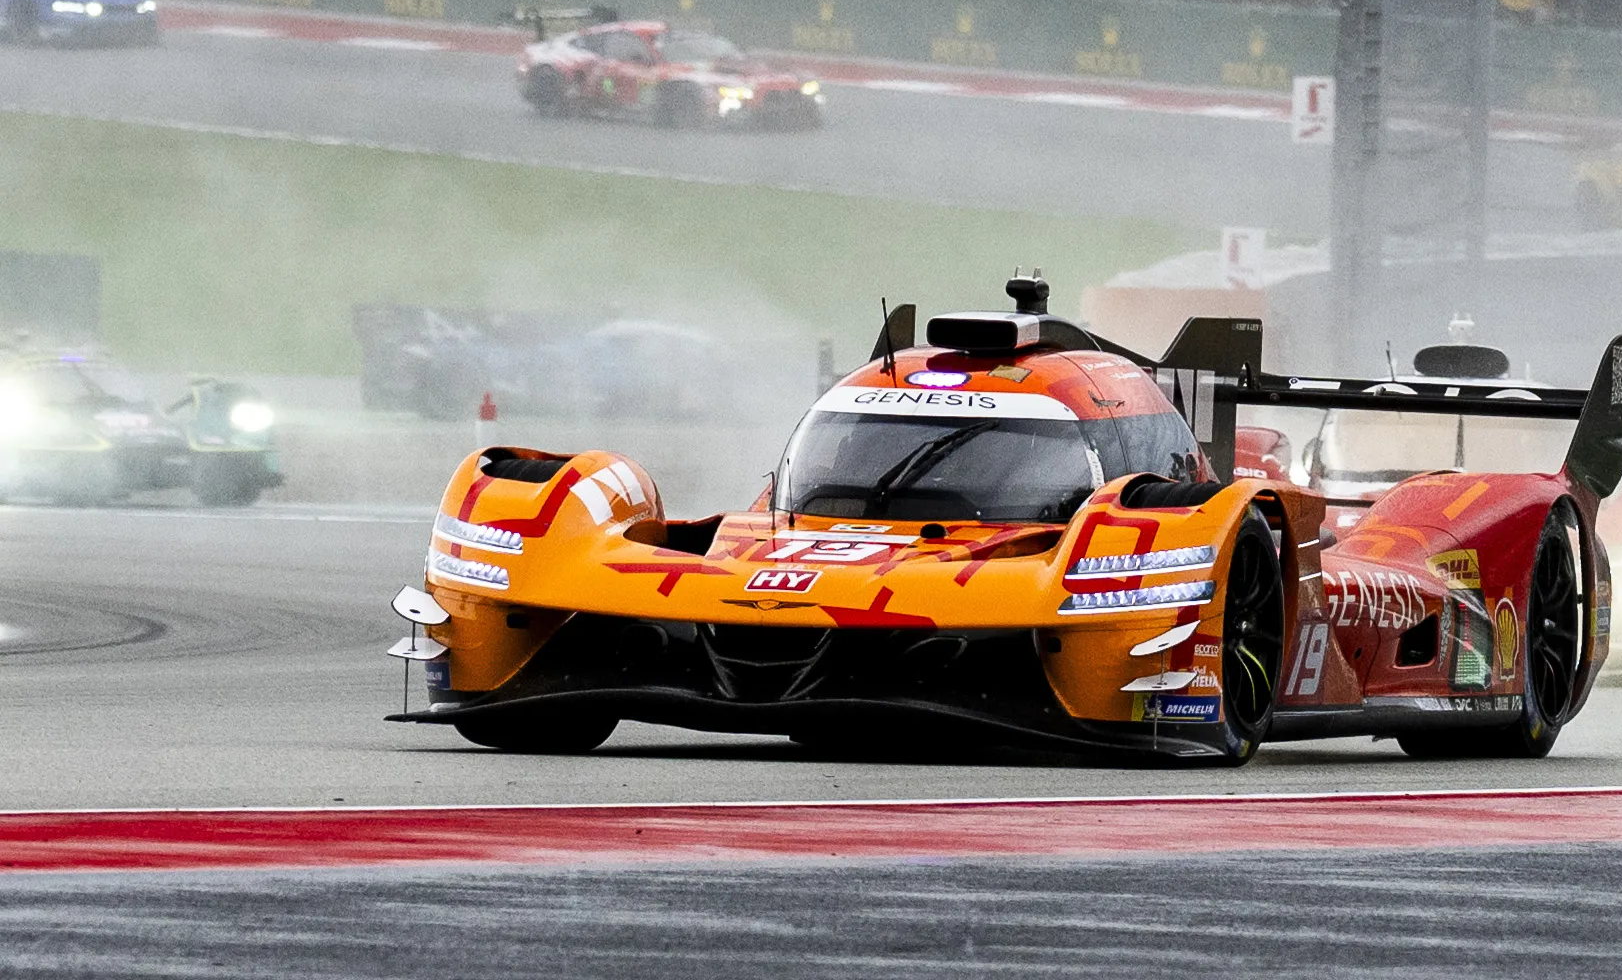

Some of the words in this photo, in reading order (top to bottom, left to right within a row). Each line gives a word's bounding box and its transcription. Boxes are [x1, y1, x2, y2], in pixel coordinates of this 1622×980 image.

[854, 389, 997, 410] GENESIS
[764, 540, 891, 562] 19
[752, 571, 813, 588] HY
[1284, 622, 1329, 696] 19
[1165, 704, 1216, 715] MICHELIN
